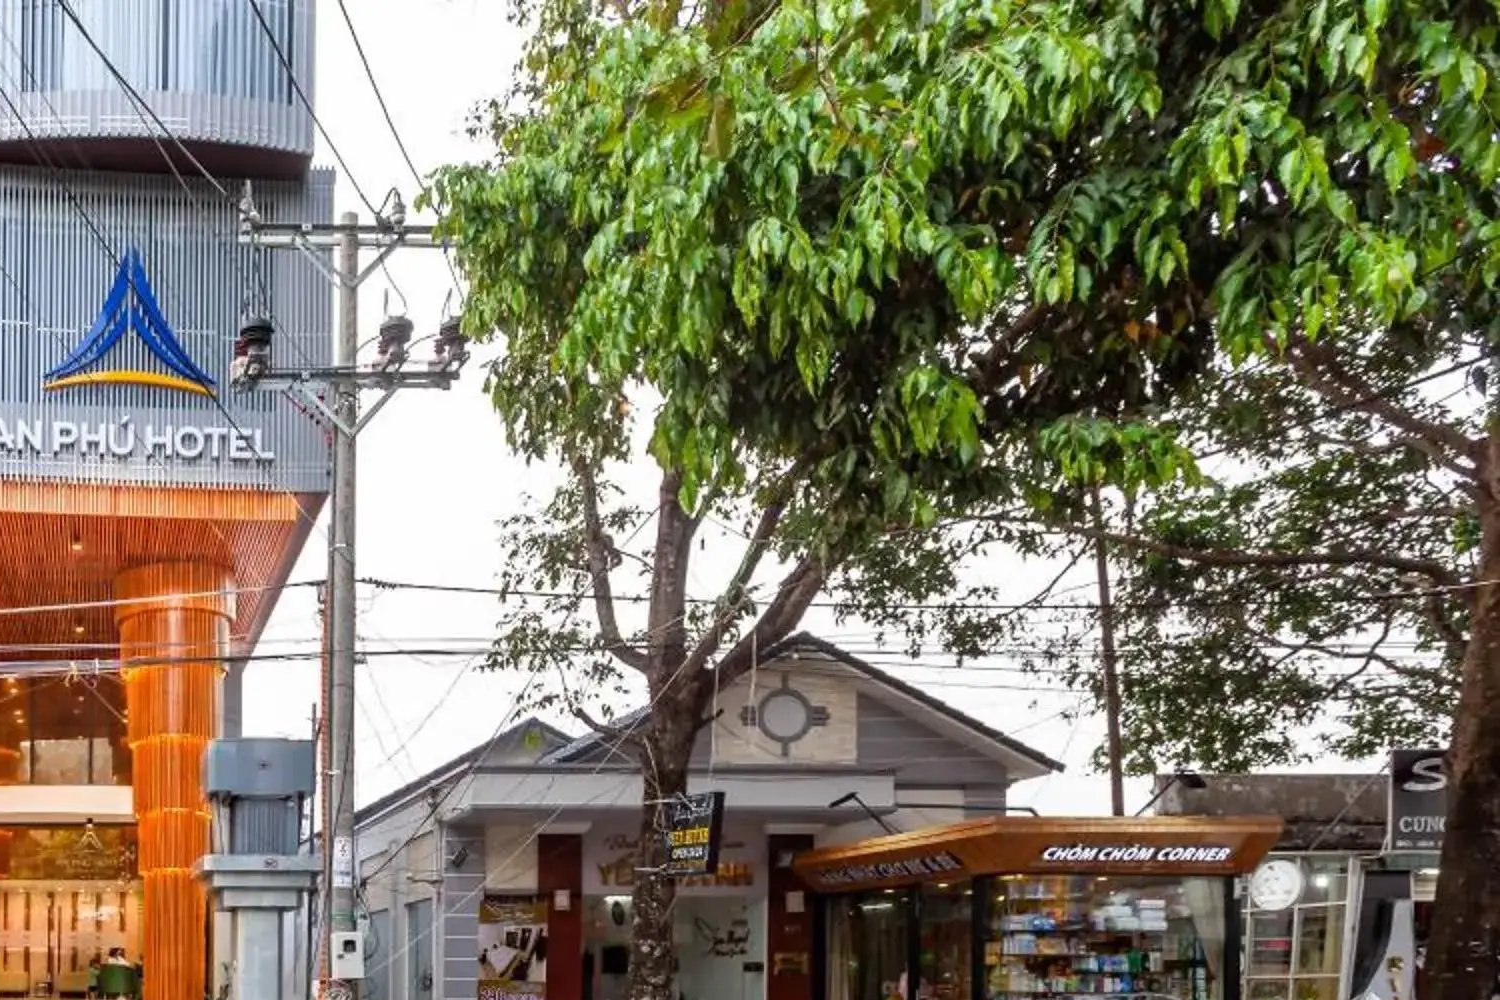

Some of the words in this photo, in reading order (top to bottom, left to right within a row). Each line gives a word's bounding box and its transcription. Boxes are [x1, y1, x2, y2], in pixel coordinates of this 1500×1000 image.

[53, 414, 135, 455] PHÚ
[145, 424, 275, 459] HOTEL
[1157, 847, 1231, 861] CORNER
